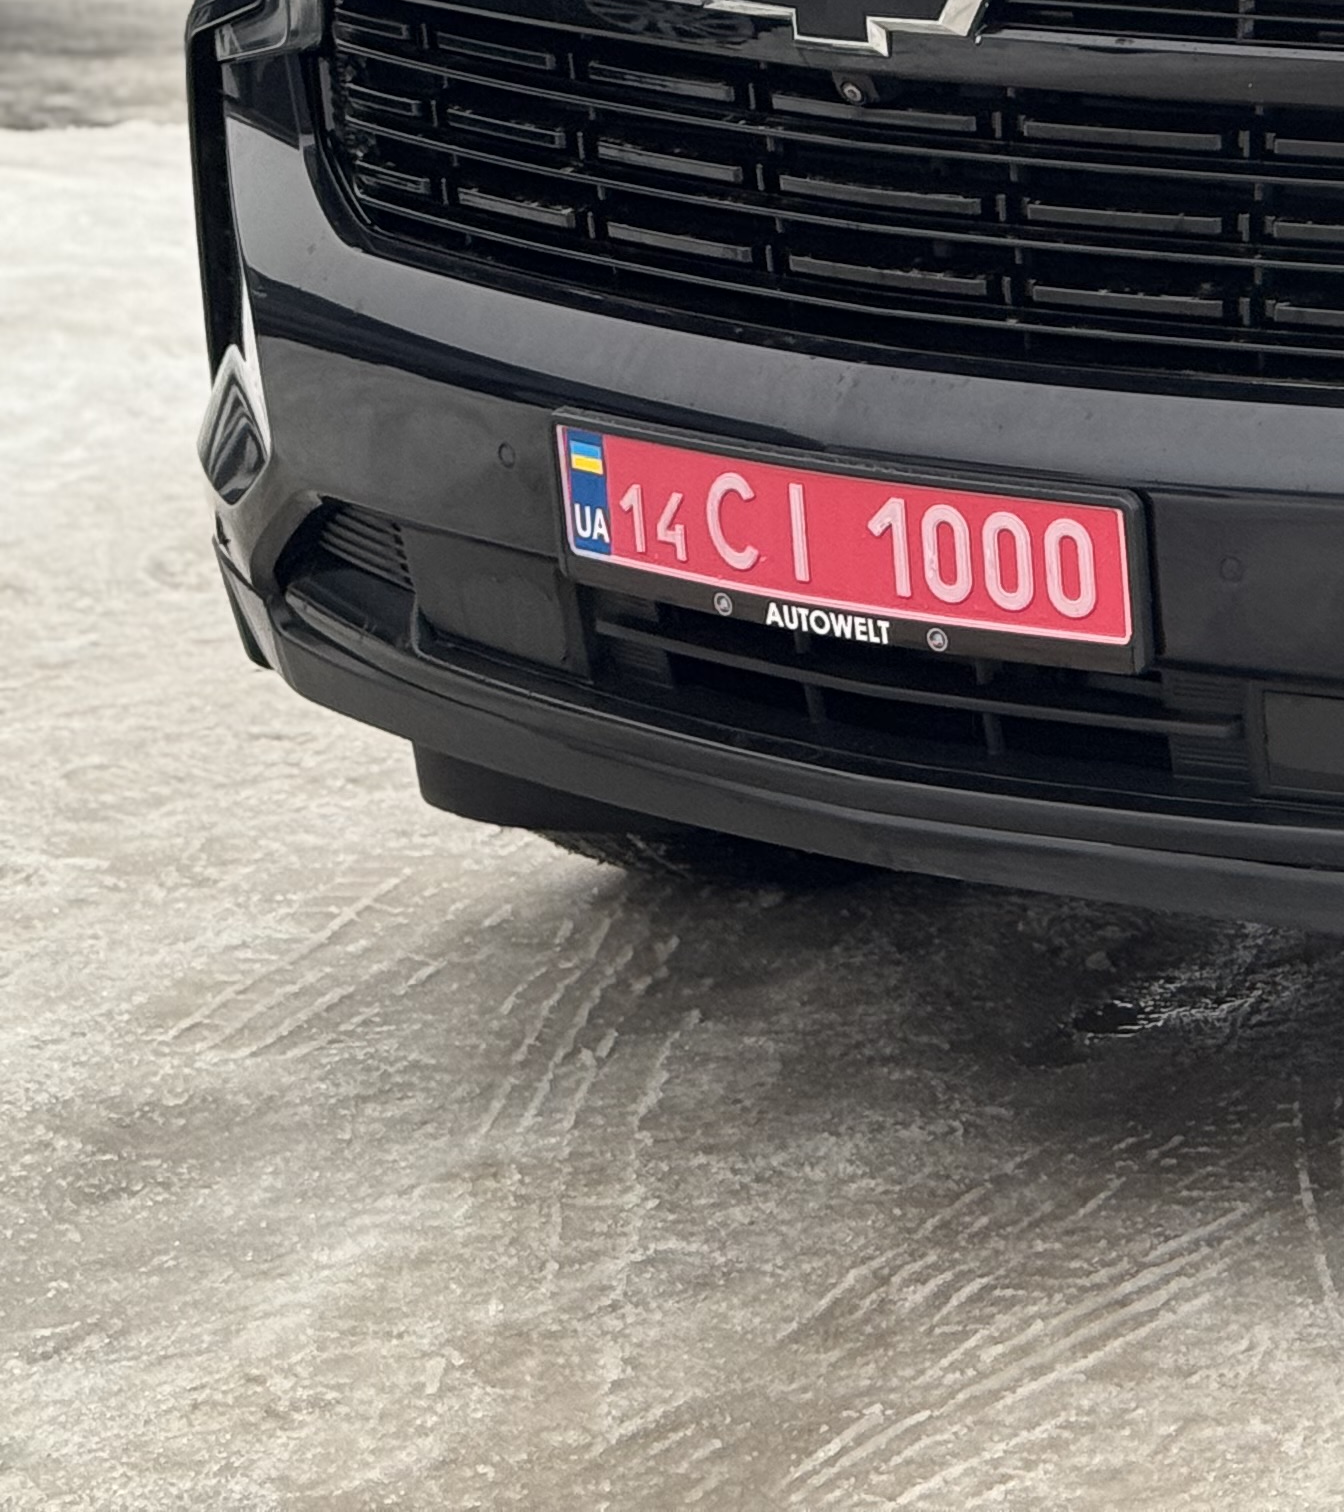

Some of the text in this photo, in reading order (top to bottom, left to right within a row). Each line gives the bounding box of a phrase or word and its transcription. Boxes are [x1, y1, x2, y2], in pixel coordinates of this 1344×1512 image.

[574, 503, 611, 544] UA
[867, 497, 1097, 620] 1000
[764, 602, 891, 646] AUTOWELT
